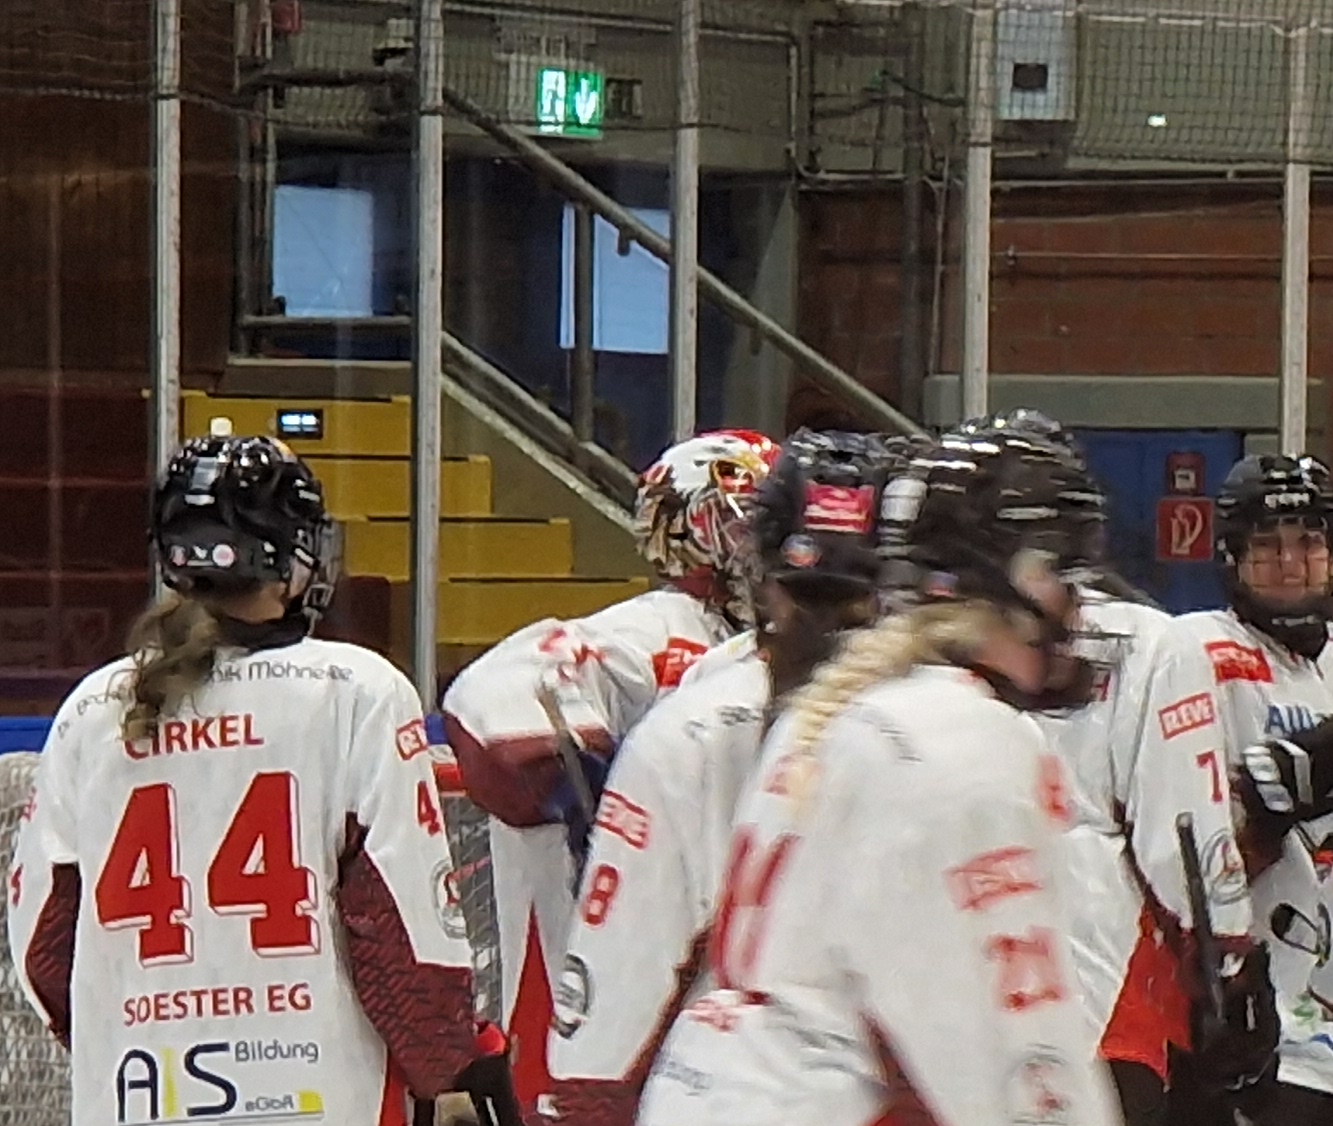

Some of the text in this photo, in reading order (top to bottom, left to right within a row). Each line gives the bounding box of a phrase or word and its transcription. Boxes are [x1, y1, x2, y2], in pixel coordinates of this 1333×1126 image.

[96, 771, 322, 968] 44
[584, 864, 619, 926] 8
[122, 982, 313, 1027] SOESTER EG
[116, 1040, 320, 1123] AIS Bildung
